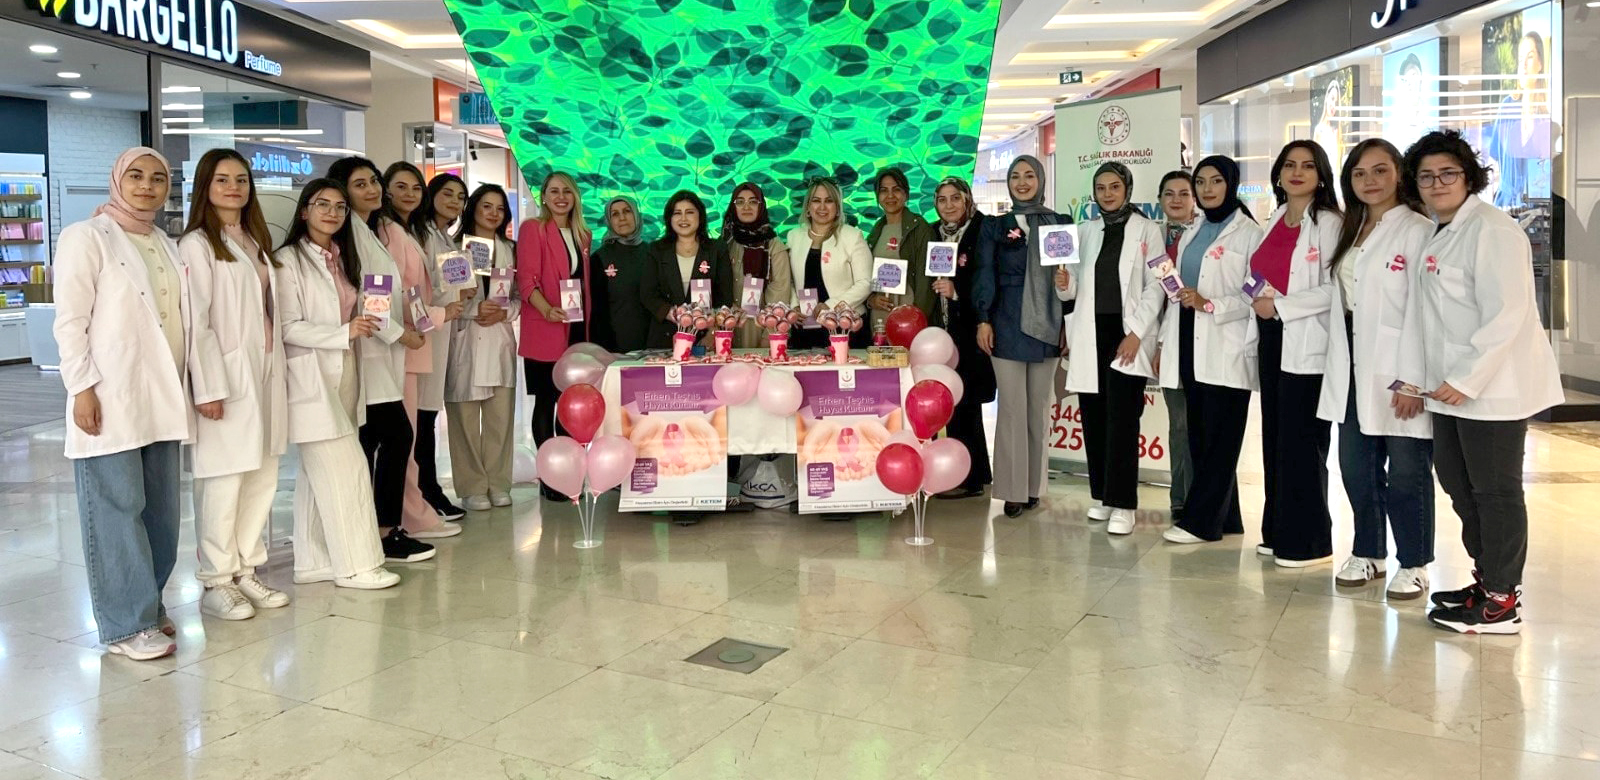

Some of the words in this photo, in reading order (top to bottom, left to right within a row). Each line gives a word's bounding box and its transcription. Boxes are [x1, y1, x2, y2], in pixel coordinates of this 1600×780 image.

[244, 50, 282, 77] Perfume
[1112, 147, 1153, 158] BAKANLIĞI
[643, 391, 671, 401] Erken
[672, 391, 702, 403] Teşhis
[818, 397, 845, 405] Erken
[845, 395, 875, 406] Teşhis
[644, 401, 670, 410] Hayat
[818, 406, 843, 415] Hayat
[1049, 425, 1083, 451] 25
